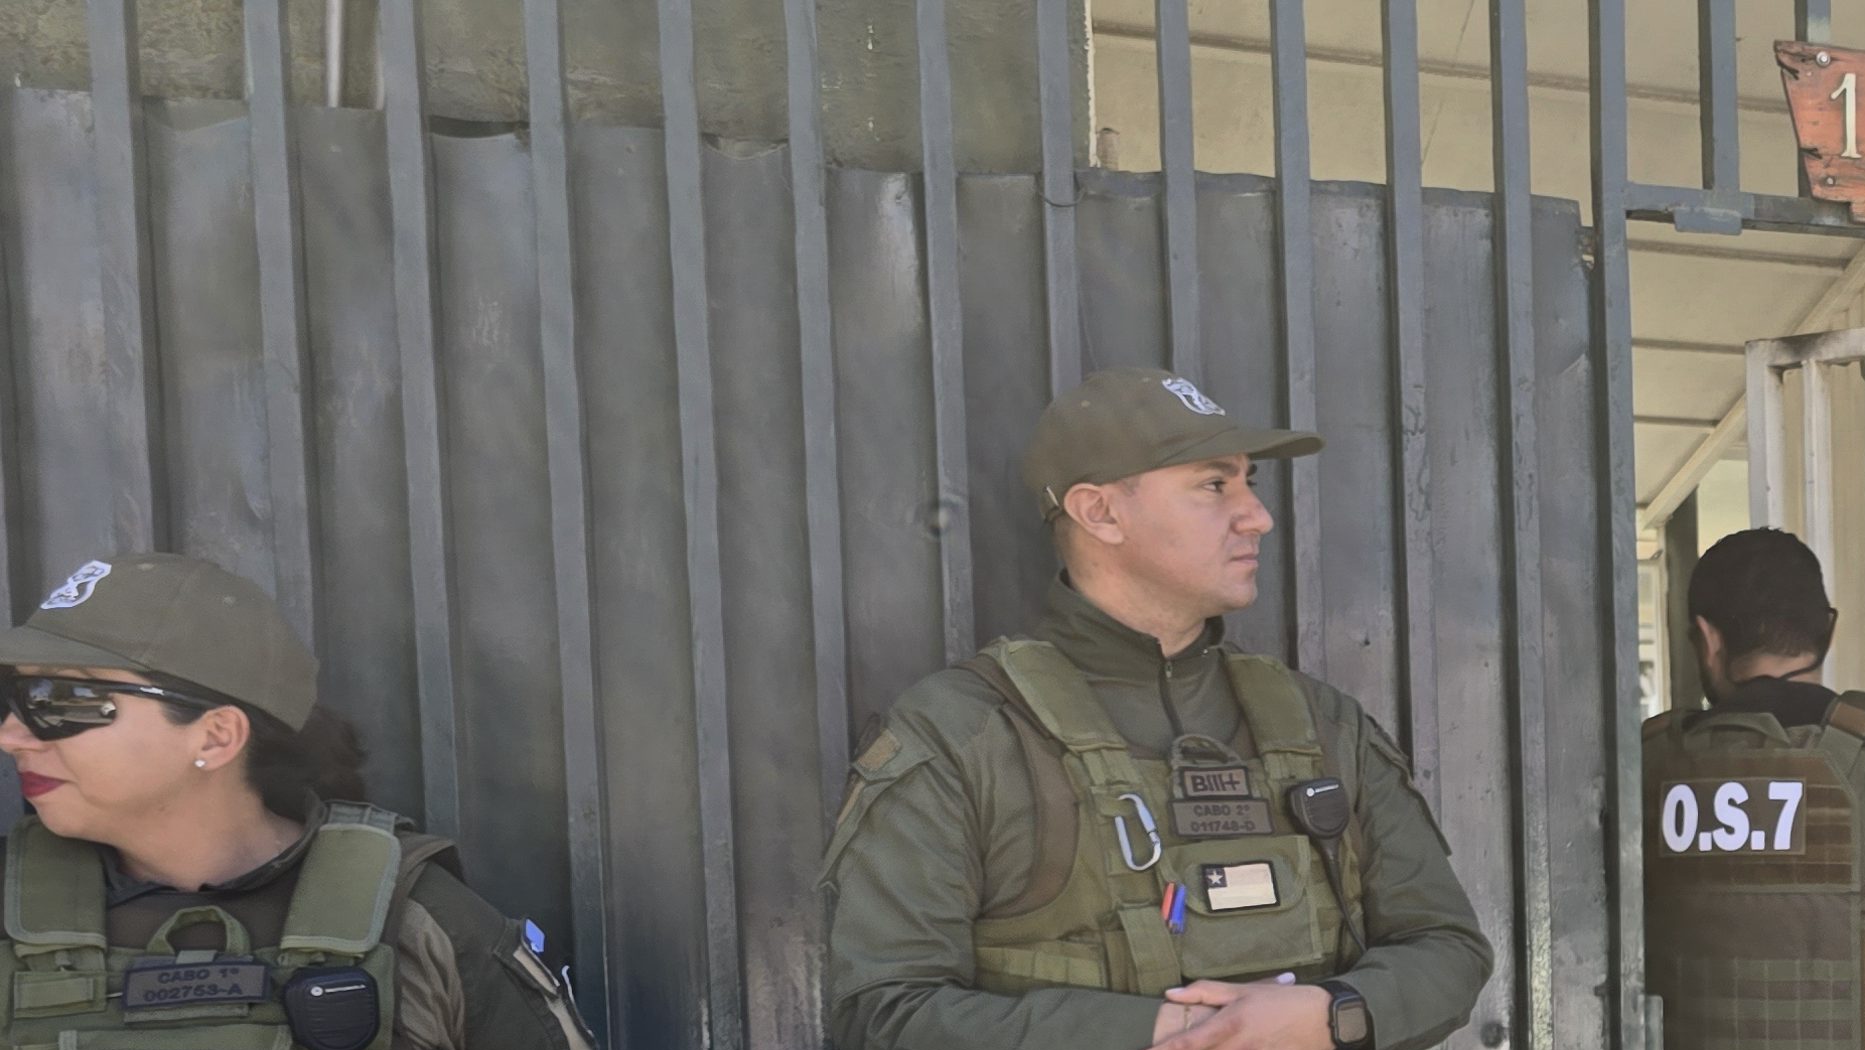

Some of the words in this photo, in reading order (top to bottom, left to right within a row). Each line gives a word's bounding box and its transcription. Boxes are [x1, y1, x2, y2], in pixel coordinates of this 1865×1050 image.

[1193, 804, 1231, 817] CABO
[1661, 780, 1804, 853] O.S.7
[158, 968, 211, 984] CABO
